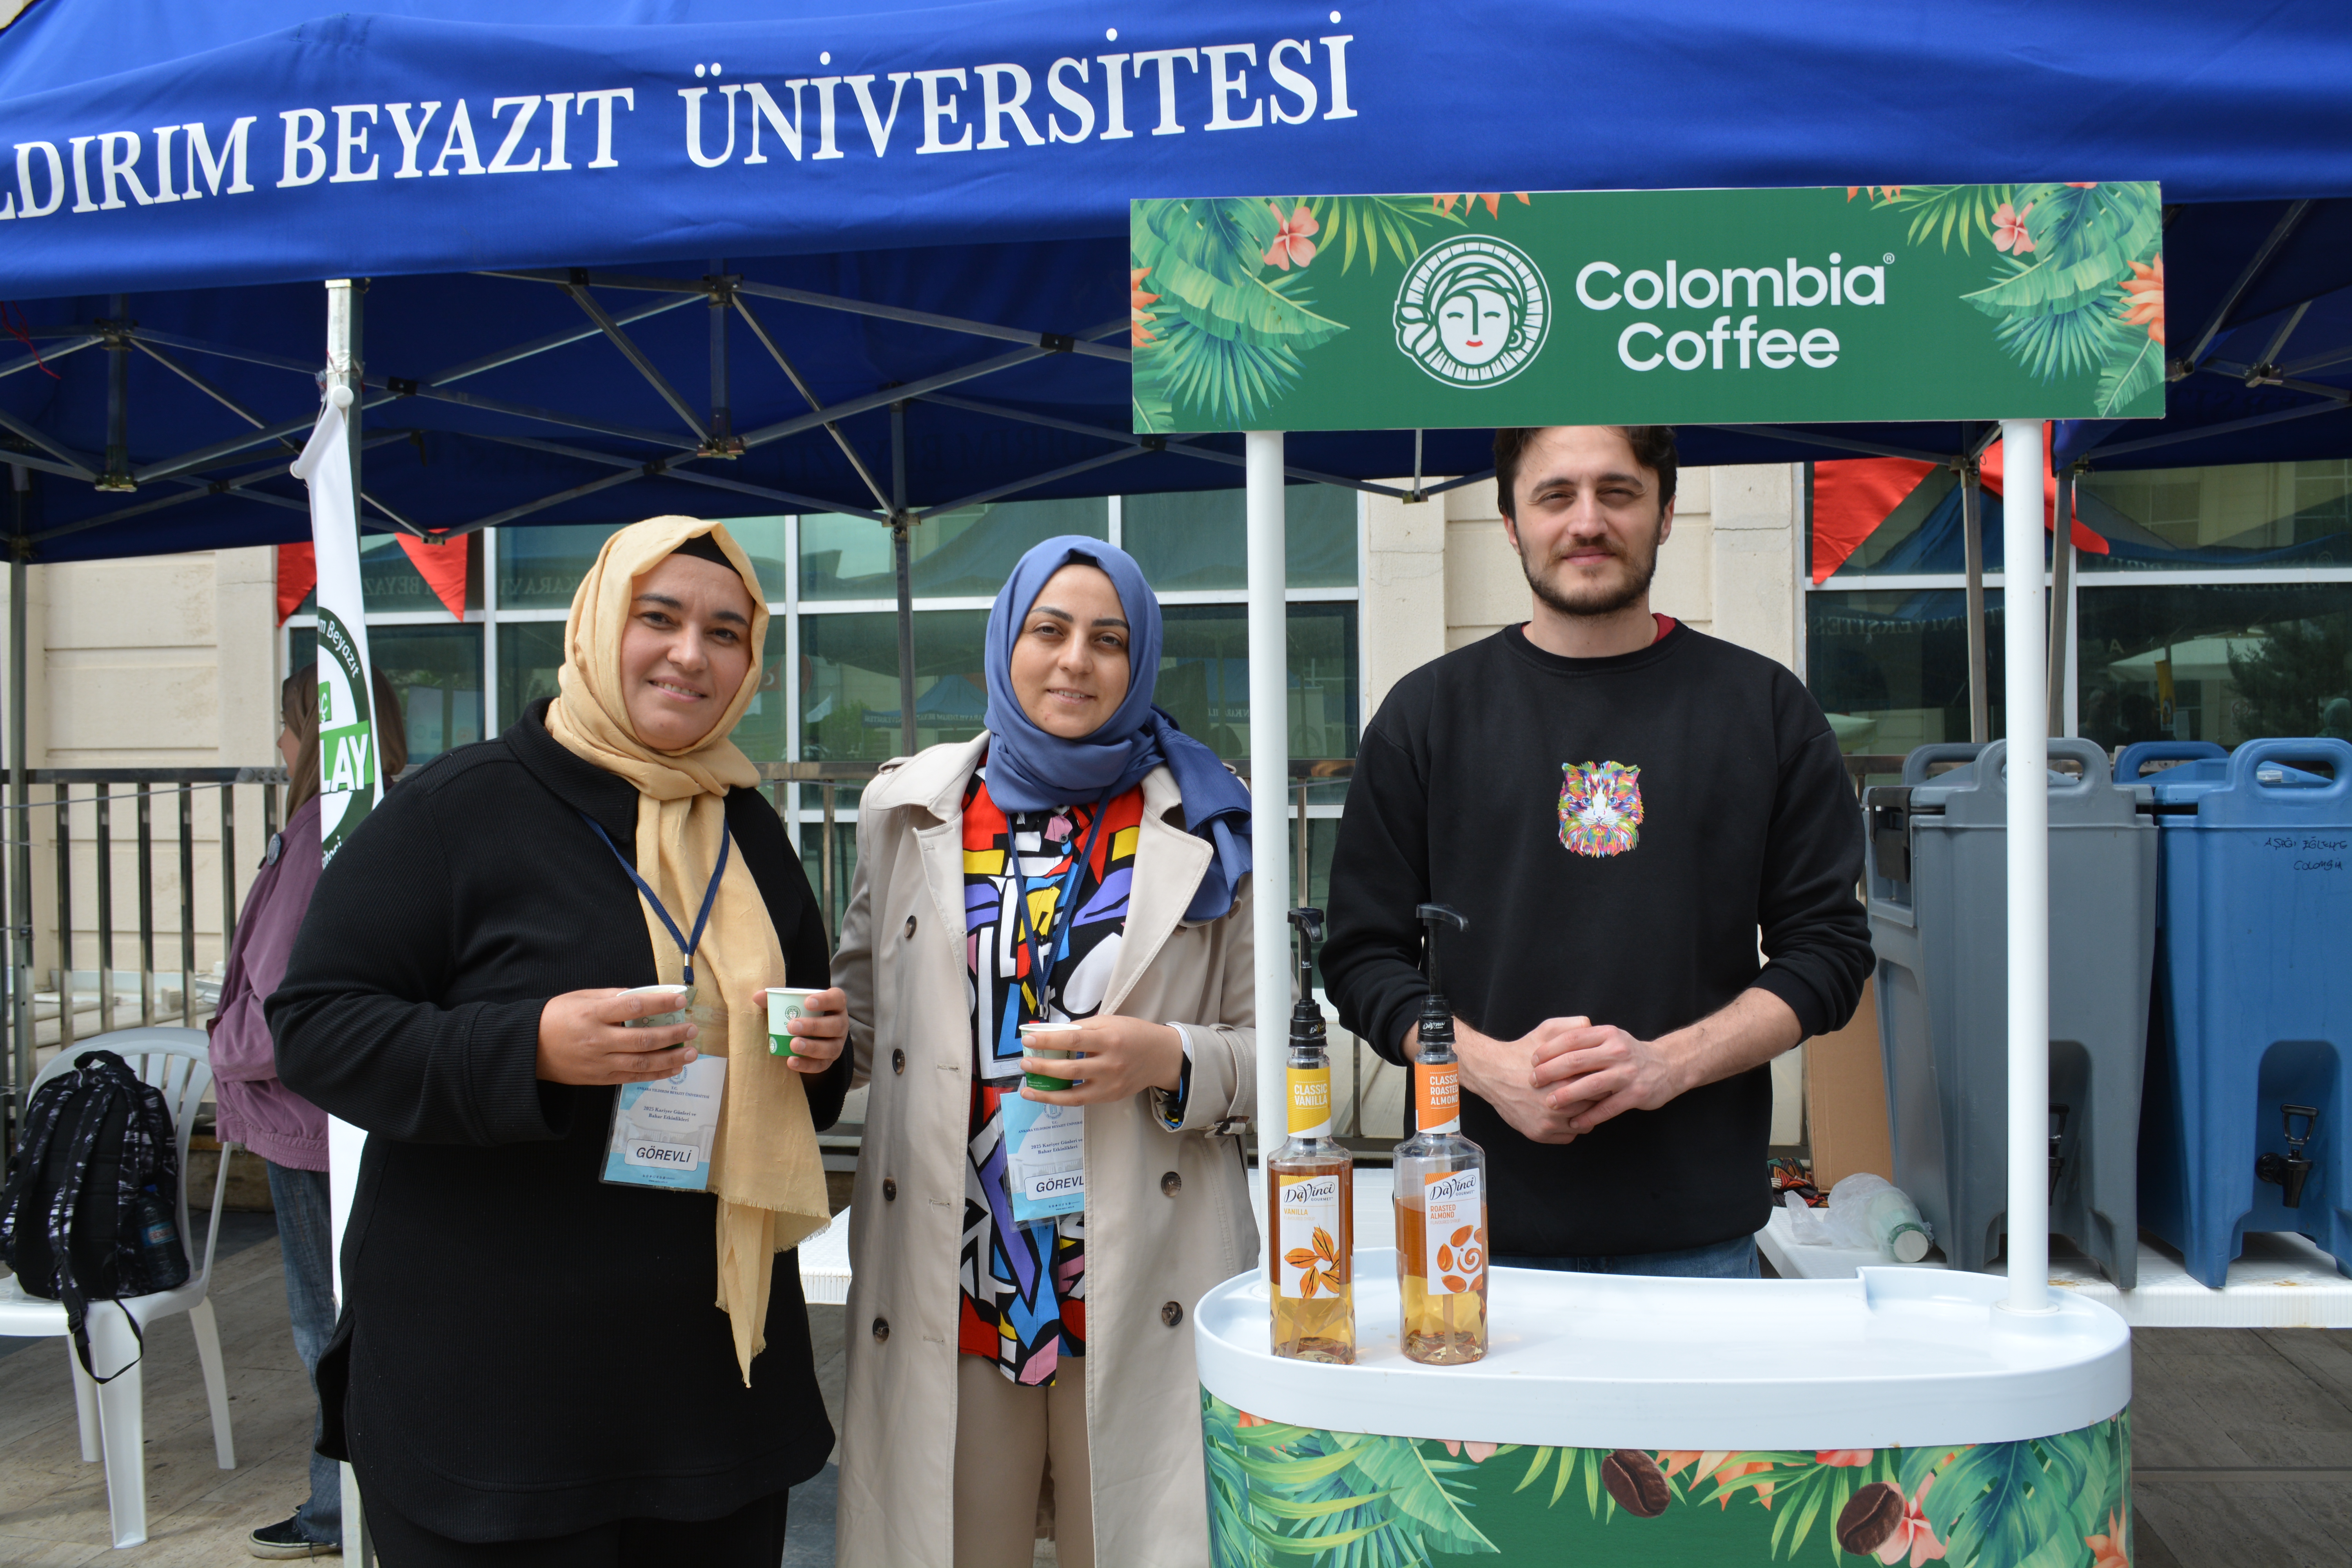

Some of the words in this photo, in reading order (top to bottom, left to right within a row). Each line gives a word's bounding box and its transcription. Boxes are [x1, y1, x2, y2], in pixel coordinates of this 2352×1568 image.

[277, 87, 633, 188] BEYAZIT
[678, 10, 1357, 168] ÜNİVERSİTESİ
[1618, 315, 1840, 371] Coffee
[1430, 1073, 1458, 1085] CLASSIC
[1294, 1083, 1327, 1095] CLASSIC
[1430, 1084, 1458, 1095] ROASTED
[1294, 1094, 1327, 1106] VANILLA
[1430, 1094, 1458, 1105] ALMOND
[636, 1145, 692, 1163] GÖREVLİ
[1284, 1181, 1335, 1204] DaVinci
[1430, 1174, 1476, 1201] DaVinci
